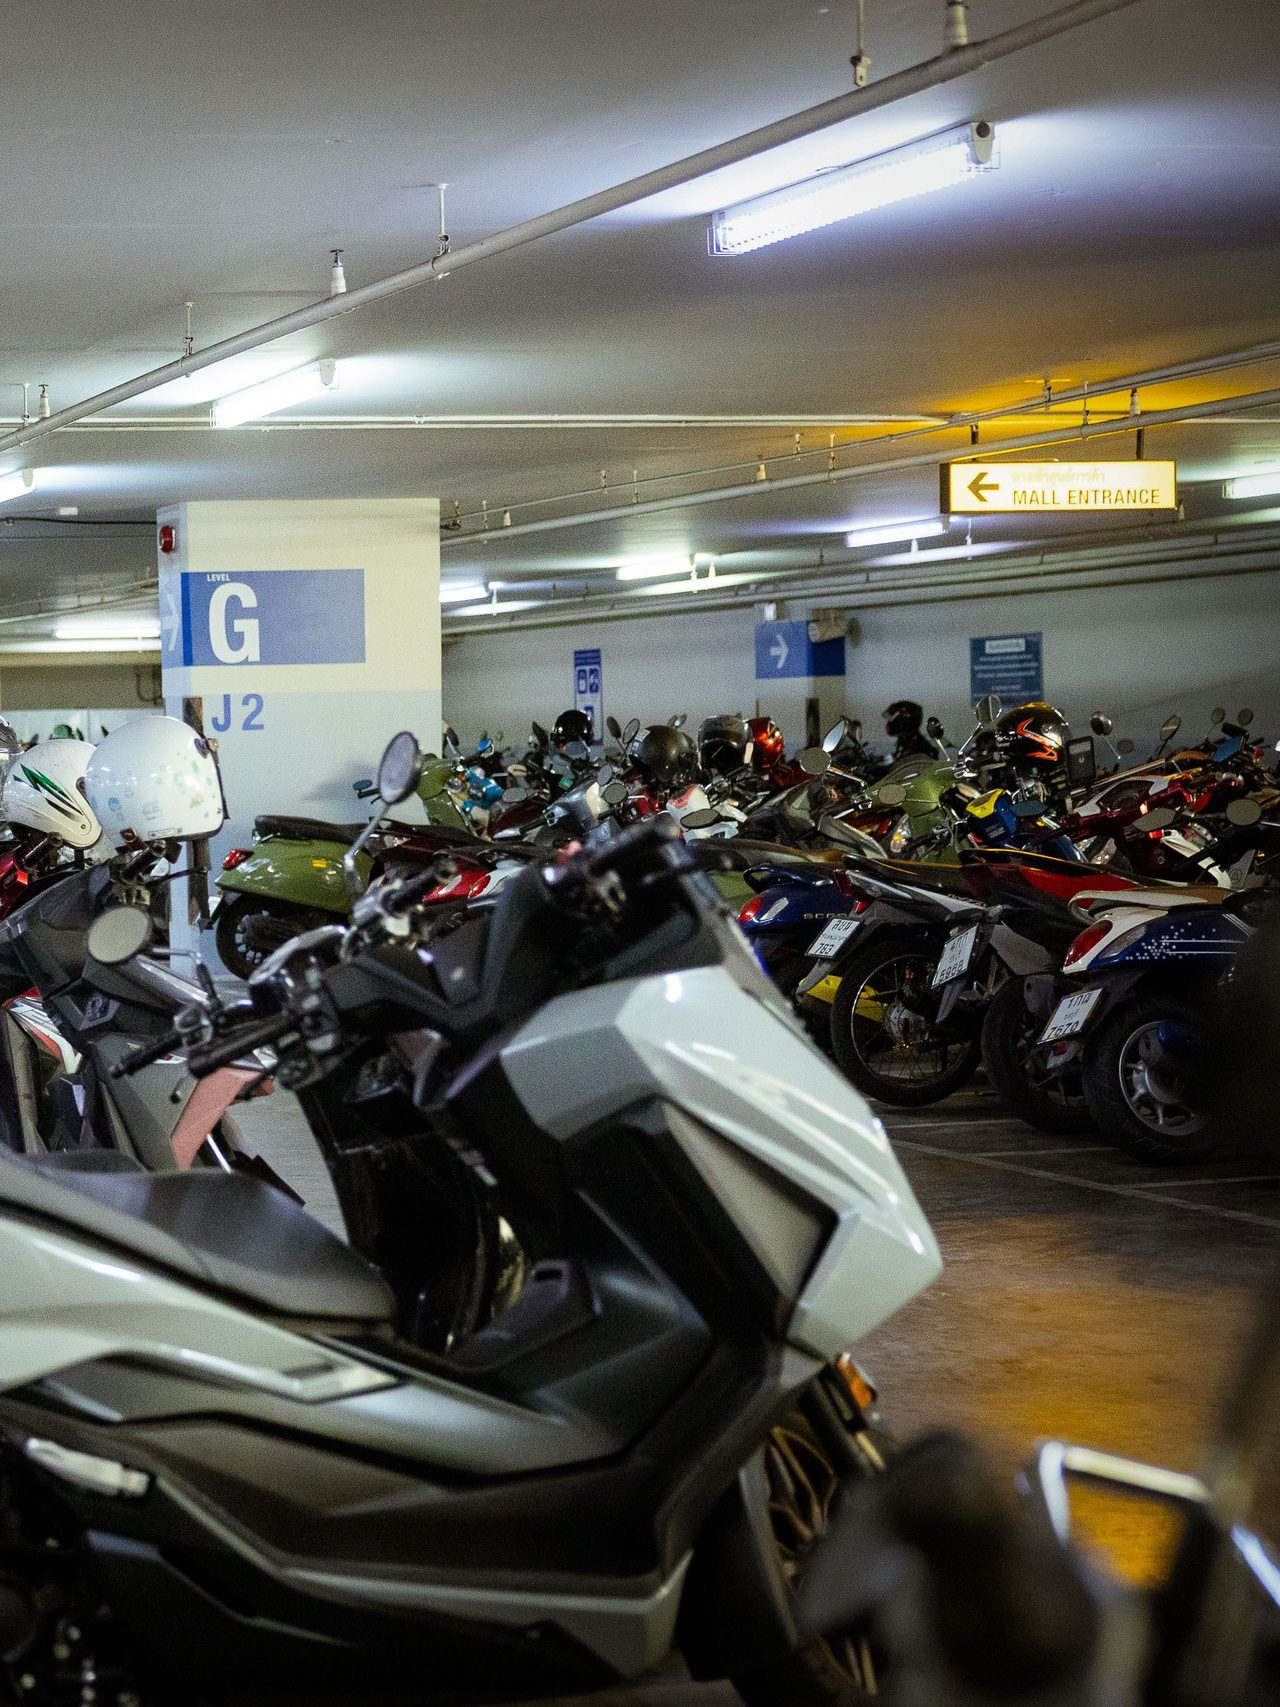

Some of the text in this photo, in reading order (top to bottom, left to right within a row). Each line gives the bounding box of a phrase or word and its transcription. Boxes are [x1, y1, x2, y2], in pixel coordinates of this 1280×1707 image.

[1013, 488, 1160, 505] MALL ENTRANCE
[206, 573, 231, 582] LEVEL
[208, 582, 261, 664] G
[814, 942, 835, 955] 783
[1046, 1020, 1080, 1040] 7670
